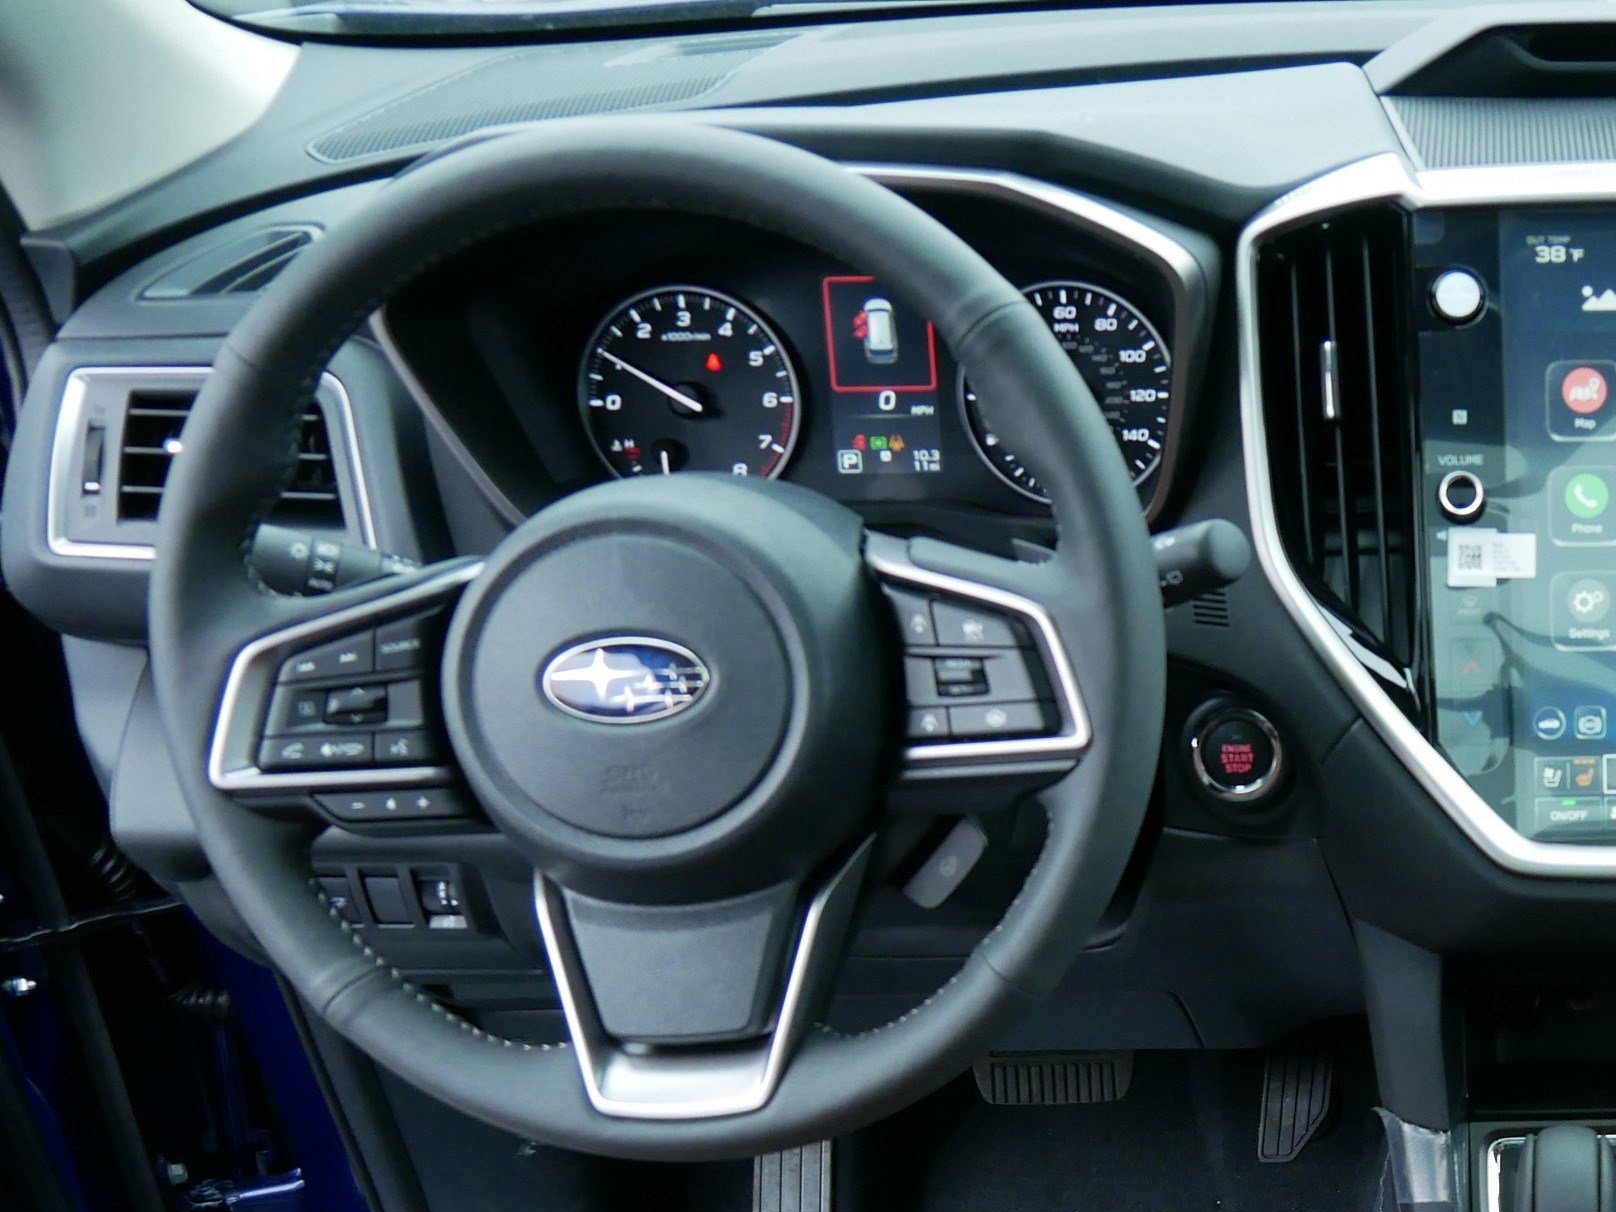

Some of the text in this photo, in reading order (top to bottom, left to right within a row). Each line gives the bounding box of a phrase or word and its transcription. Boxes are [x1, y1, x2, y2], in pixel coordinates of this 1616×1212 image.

[1534, 245, 1567, 263] 38
[676, 311, 691, 327] 3
[1053, 306, 1077, 320] 60
[636, 323, 652, 339] 2
[717, 322, 734, 337] 4
[1053, 322, 1079, 333] MPH
[1094, 318, 1118, 331] 80
[748, 351, 764, 367] 5
[1119, 350, 1147, 363] 100
[762, 392, 778, 408] 6
[879, 390, 897, 411] 0
[1129, 389, 1156, 402] 120
[605, 394, 622, 411] 0
[910, 405, 935, 416] MPH
[1574, 417, 1597, 430] Map
[1122, 428, 1149, 441] 140
[758, 434, 773, 449] 7
[842, 453, 858, 469] P
[1437, 454, 1484, 466] VOLUME
[732, 463, 748, 477] 8
[1571, 523, 1603, 535] Phone
[1568, 627, 1610, 640] Settings
[1220, 752, 1255, 764] START
[1225, 764, 1252, 773] STOP
[1549, 810, 1588, 822] ON/OFF
